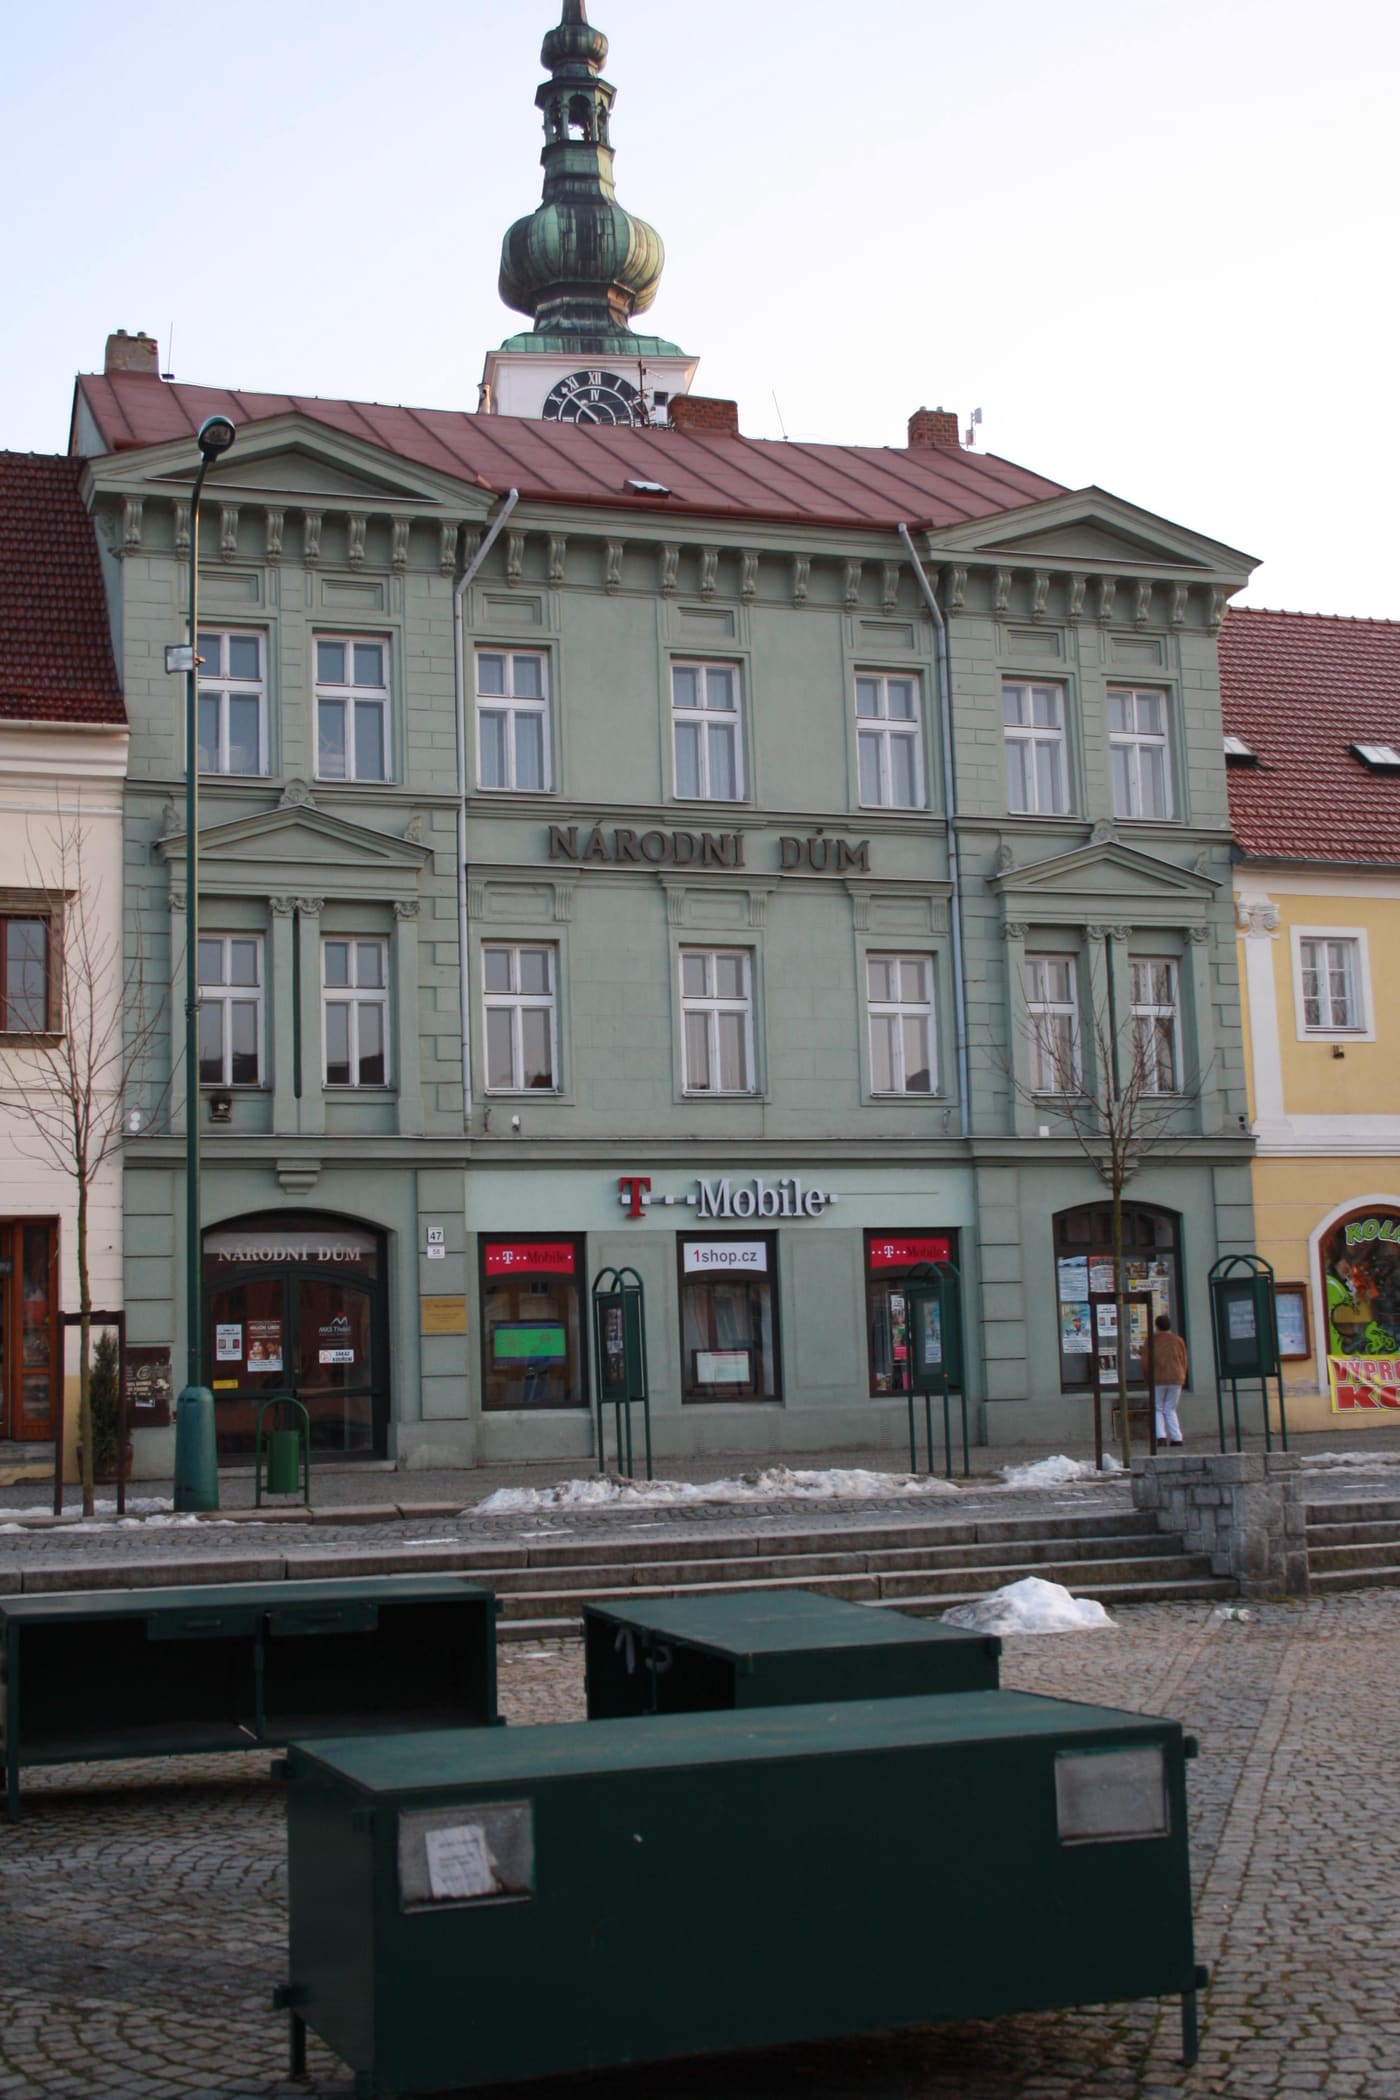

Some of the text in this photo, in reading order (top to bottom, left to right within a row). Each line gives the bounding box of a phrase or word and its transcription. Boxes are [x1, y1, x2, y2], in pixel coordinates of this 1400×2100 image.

[588, 371, 602, 385] XII
[548, 819, 871, 872] NÁRODNÍ DŮM
[697, 1177, 827, 1218] Mobile
[430, 1231, 442, 1241] 47
[218, 1242, 361, 1262] NÁRODNÍ DŮM
[693, 1249, 758, 1266] 1shop.cz
[1332, 1355, 1400, 1382] VÝPR
